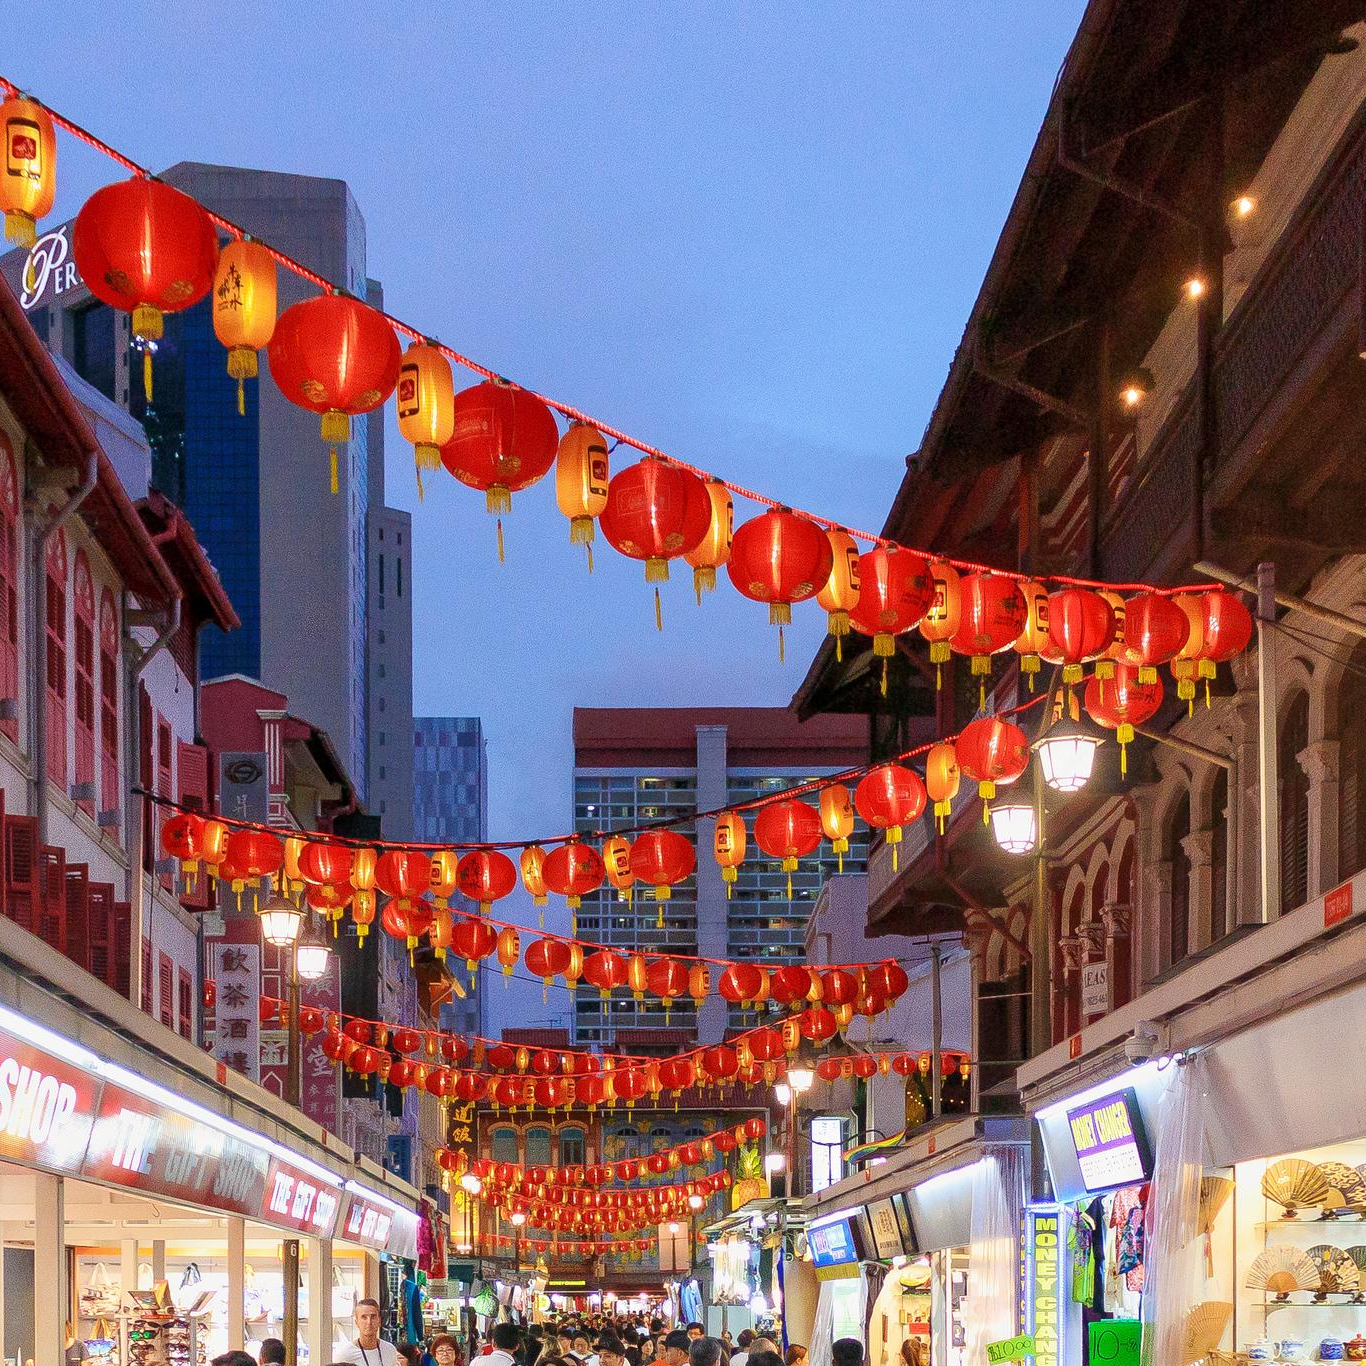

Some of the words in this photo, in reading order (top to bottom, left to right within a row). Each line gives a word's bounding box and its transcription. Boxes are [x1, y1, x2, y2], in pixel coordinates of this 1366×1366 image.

[20, 225, 84, 310] PER
[112, 1107, 162, 1174] THE
[164, 1141, 208, 1190] GIFT
[213, 1152, 258, 1201] SHOP
[270, 1171, 295, 1214] THE
[291, 1180, 317, 1222] GIFT
[290, 1244, 298, 1257] 6
[1035, 1218, 1058, 1291] MONEY
